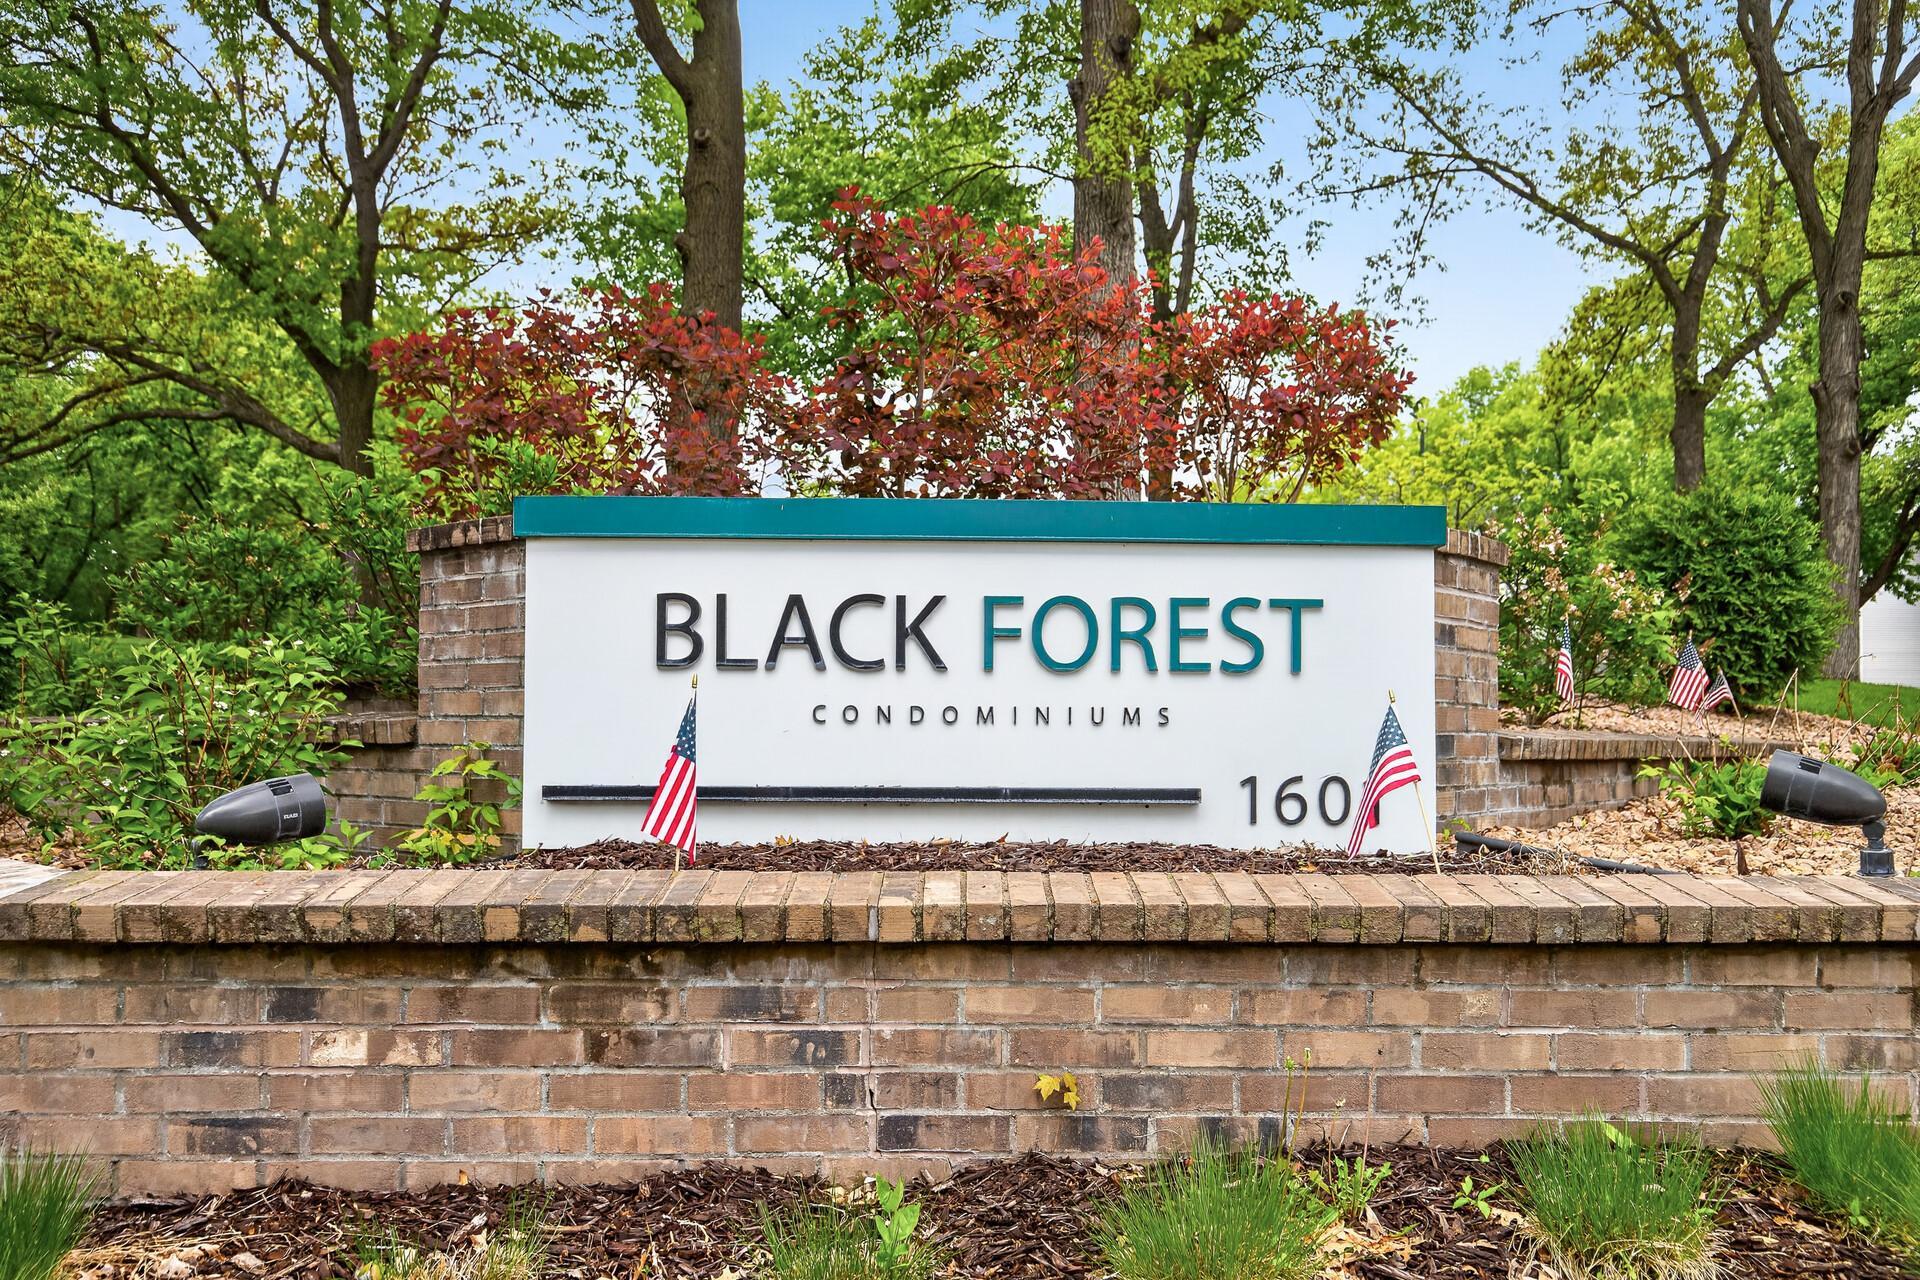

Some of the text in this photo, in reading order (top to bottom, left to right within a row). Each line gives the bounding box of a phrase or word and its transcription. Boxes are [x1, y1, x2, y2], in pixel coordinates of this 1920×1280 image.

[656, 592, 1324, 675] BLACK FOREST
[812, 704, 1171, 727] CONDOMINIUMS
